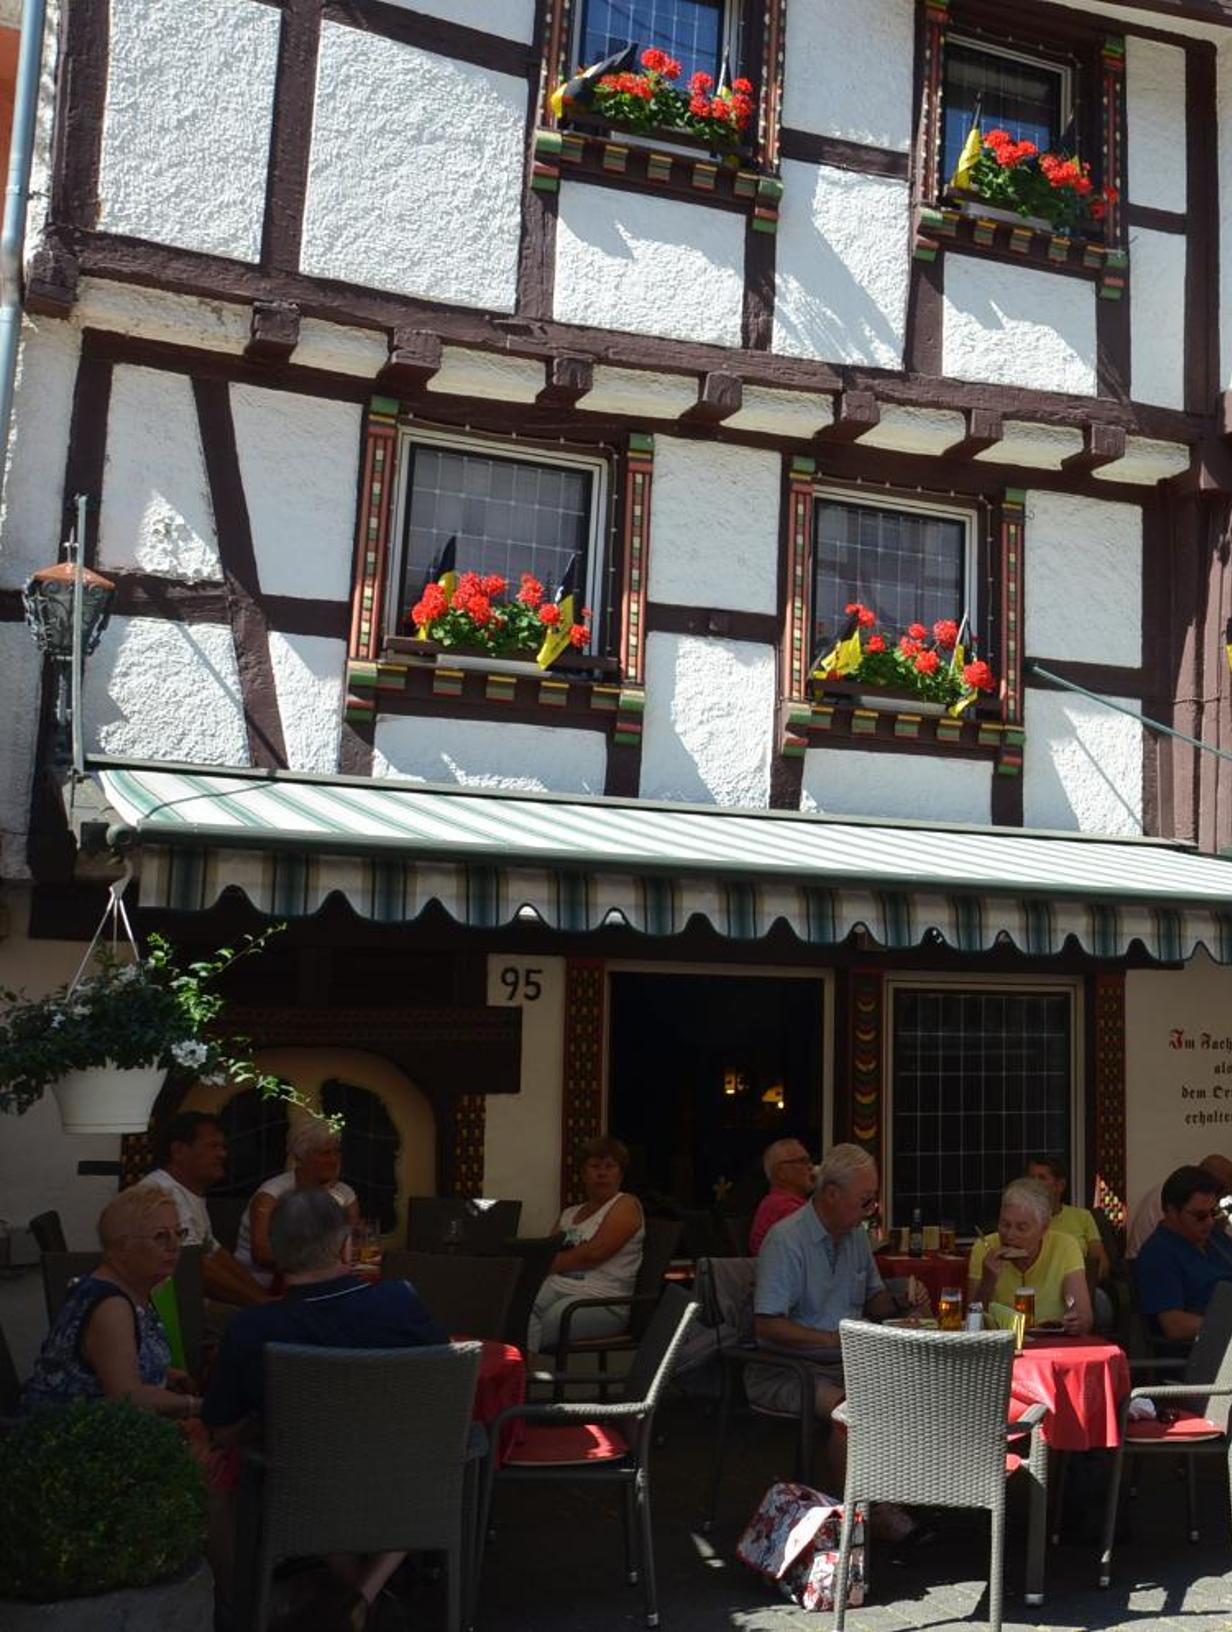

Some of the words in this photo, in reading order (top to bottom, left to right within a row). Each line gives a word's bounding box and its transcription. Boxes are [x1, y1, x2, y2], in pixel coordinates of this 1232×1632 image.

[501, 966, 543, 1002] 95
[1168, 1028, 1196, 1051] Im
[1181, 1084, 1207, 1100] dem
